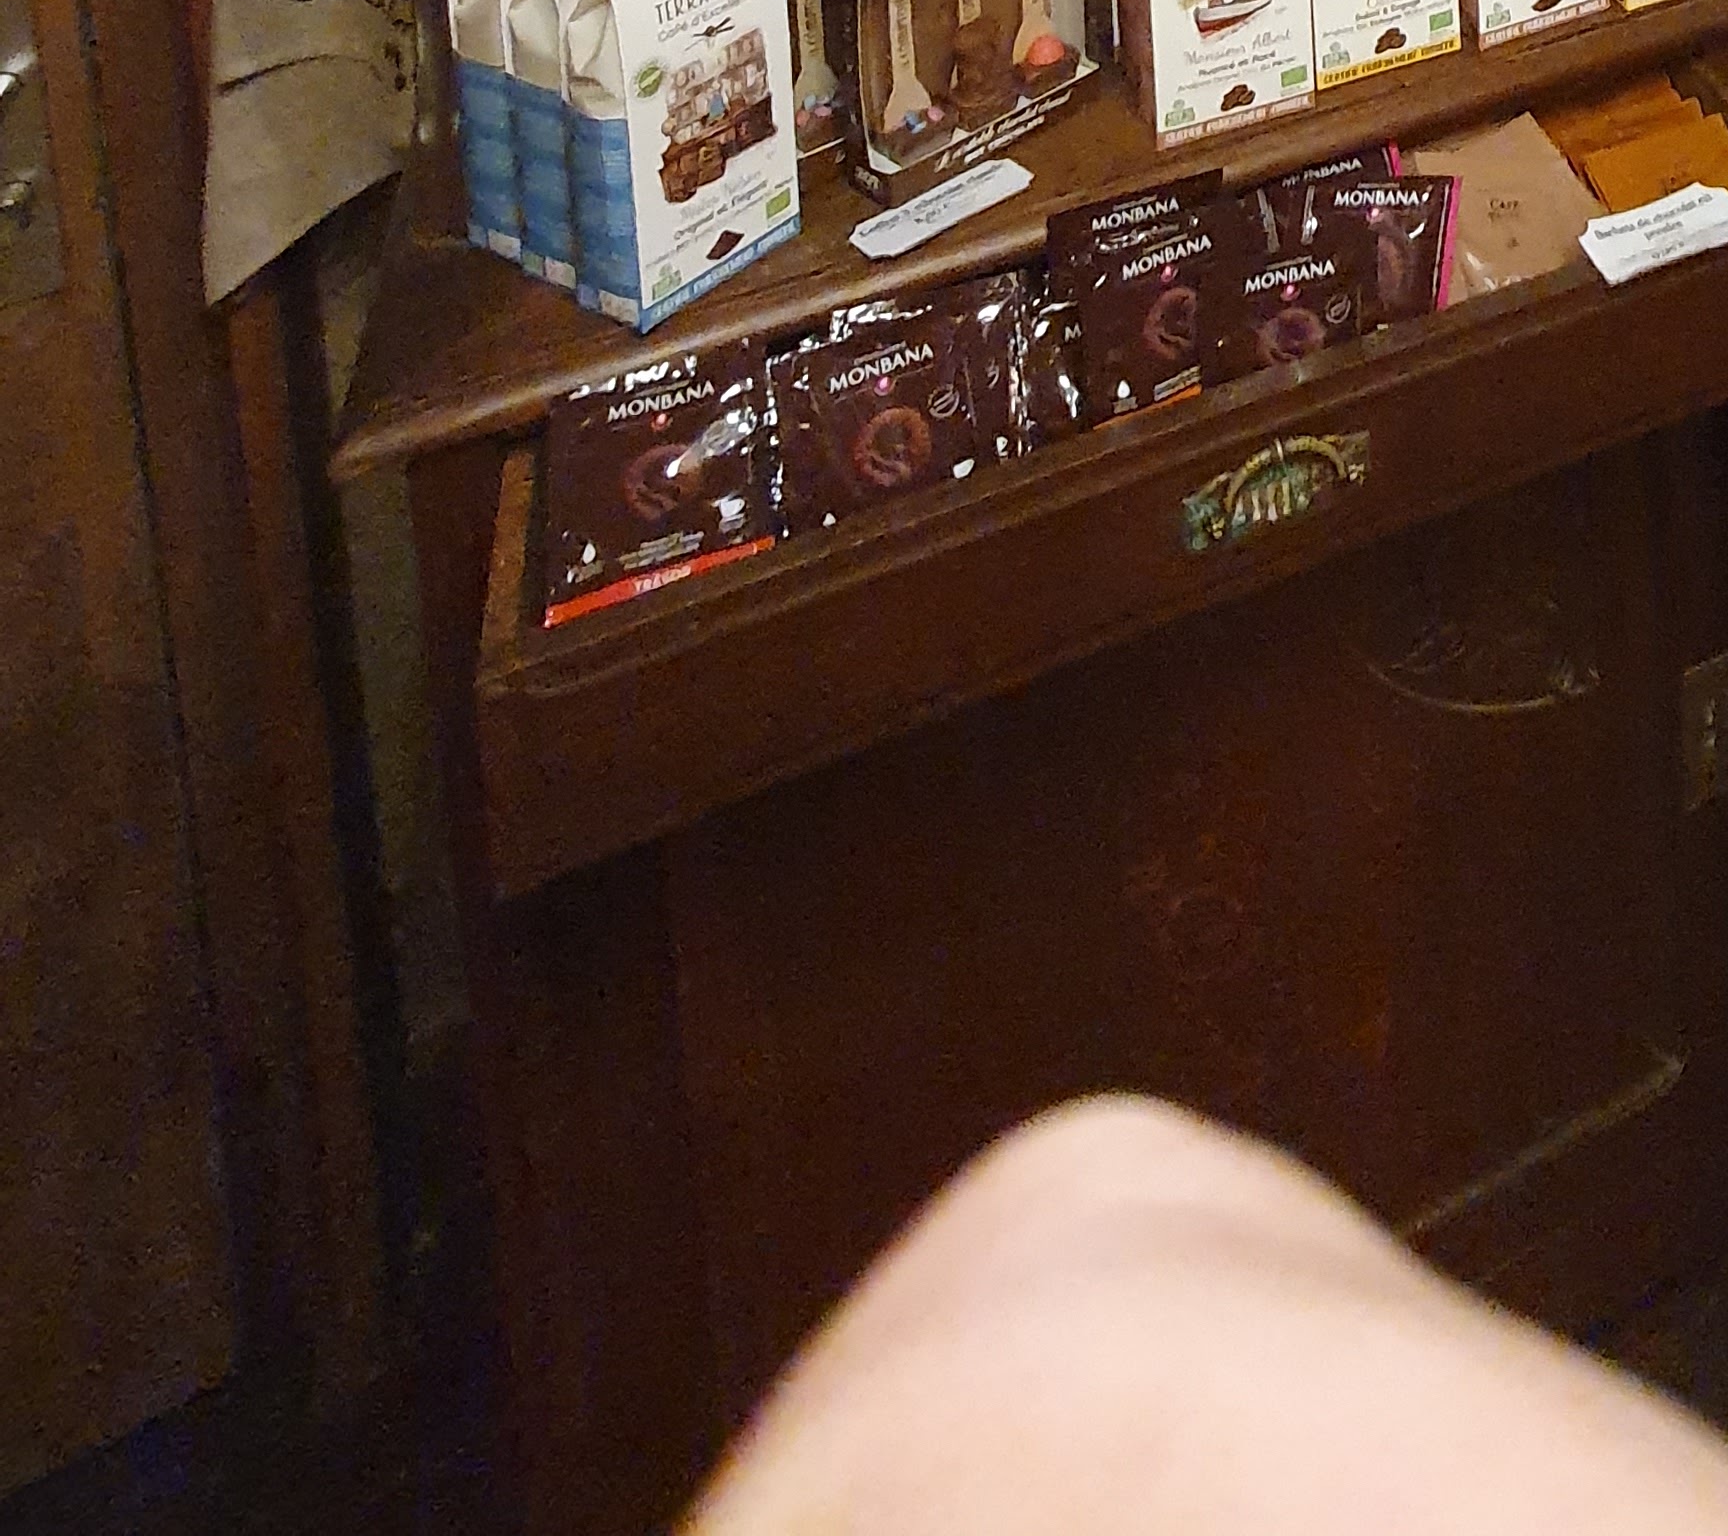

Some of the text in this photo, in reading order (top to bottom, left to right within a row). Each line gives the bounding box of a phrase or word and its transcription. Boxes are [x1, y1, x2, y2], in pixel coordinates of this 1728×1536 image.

[1091, 196, 1180, 232] MONBANA
[1333, 189, 1420, 208] MONBANA
[1121, 233, 1213, 281] MONBANA
[1243, 258, 1336, 297] MONBANA
[827, 341, 934, 395] MONBANA
[606, 379, 715, 425] MONBANA
